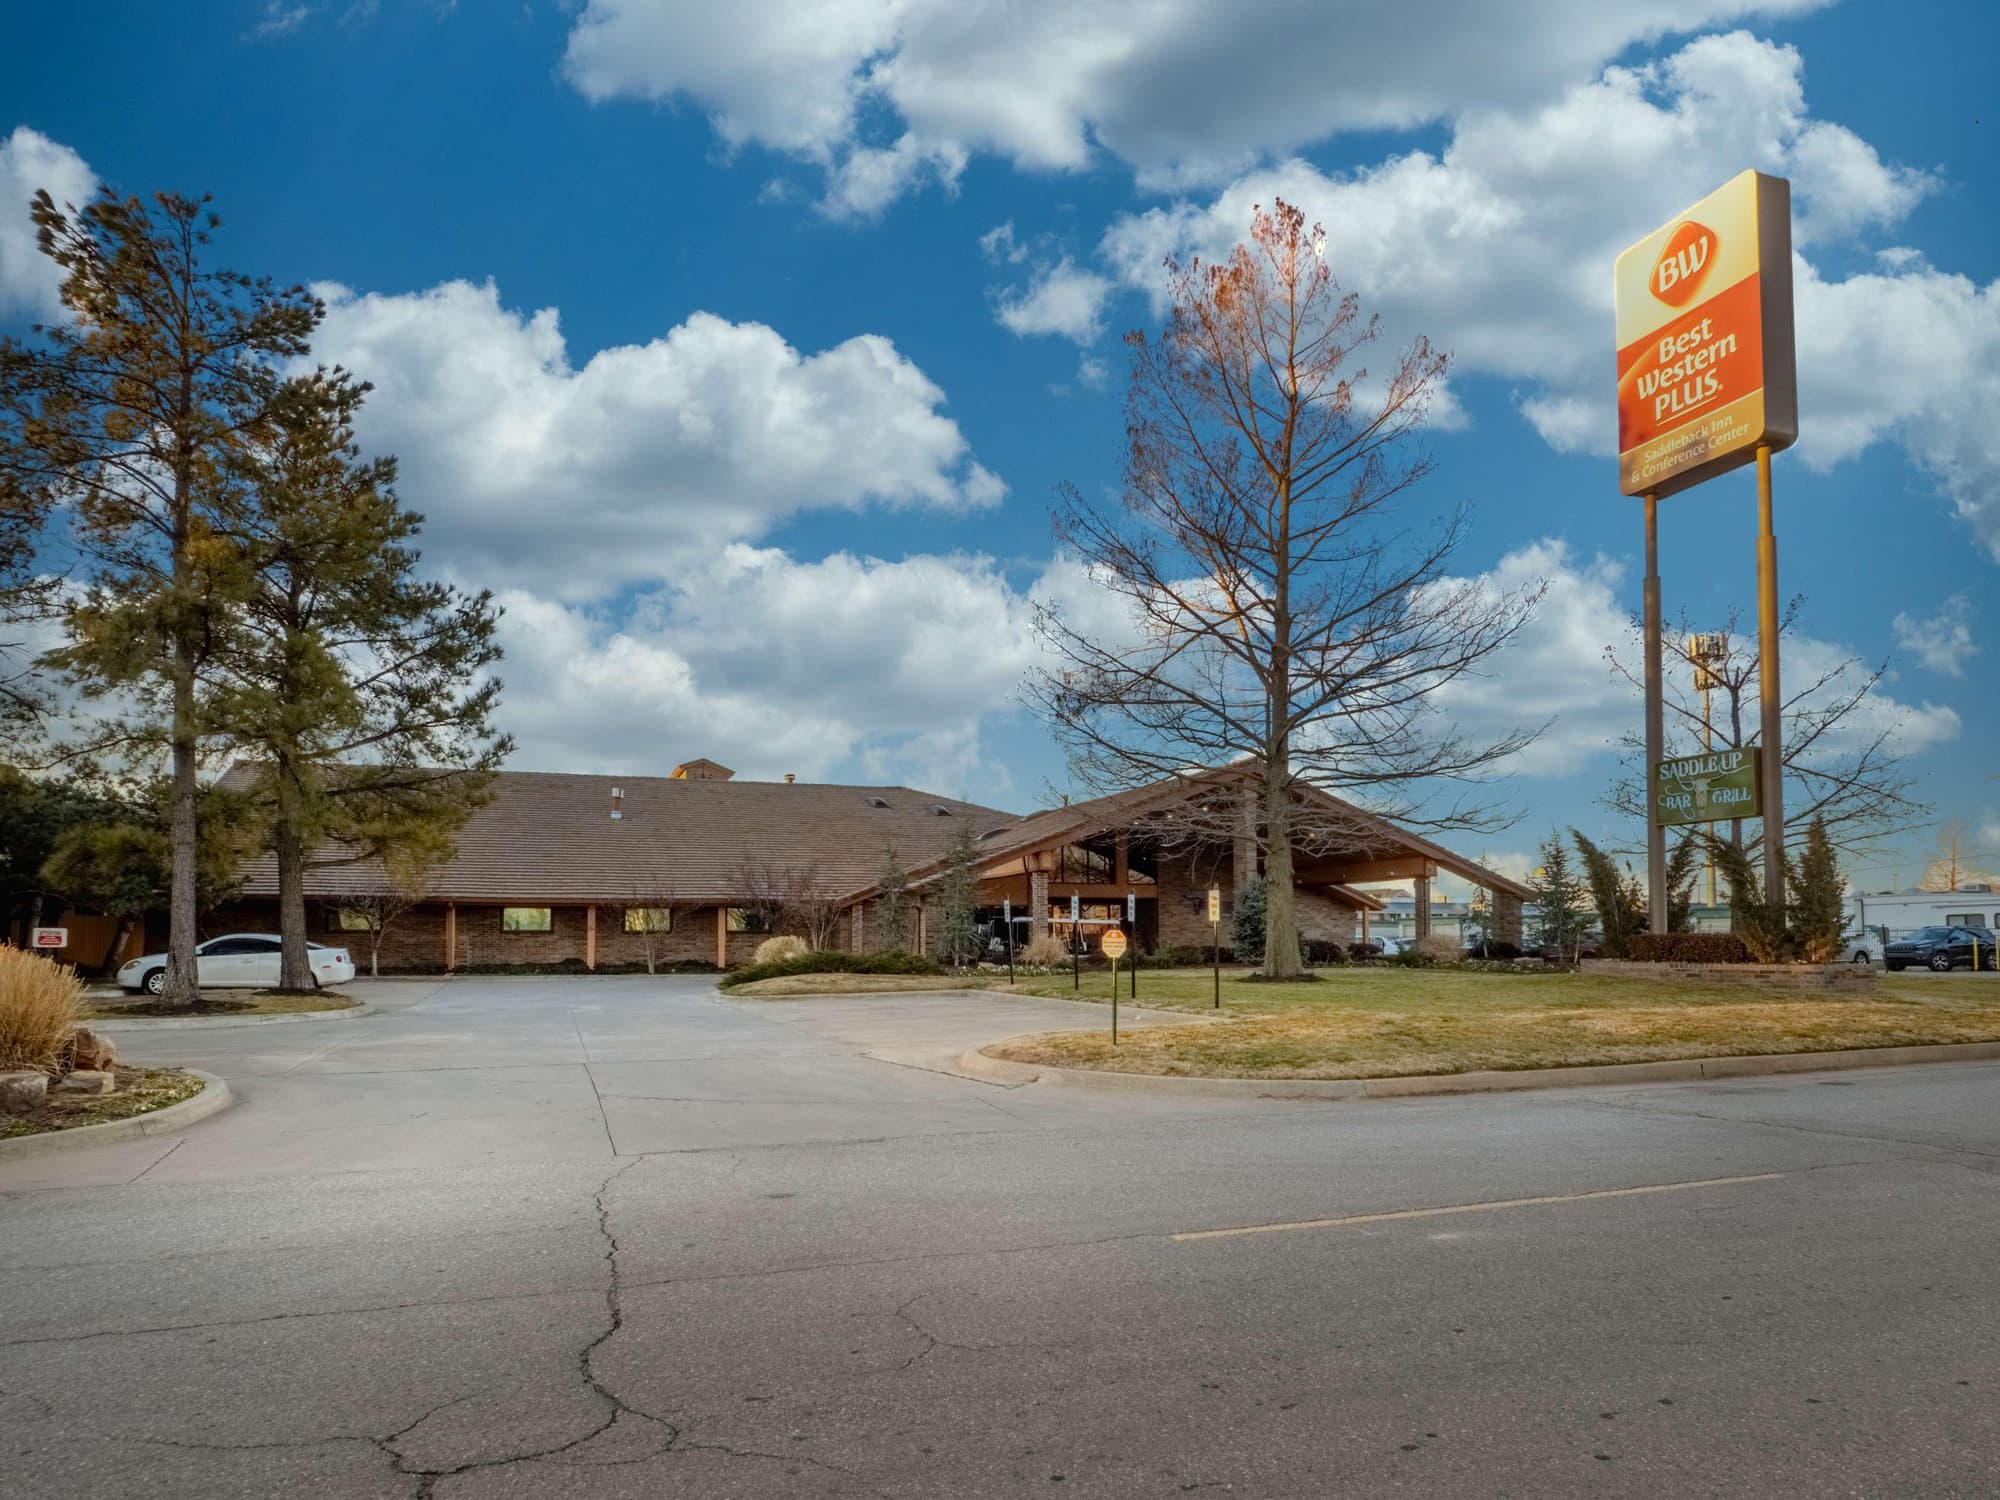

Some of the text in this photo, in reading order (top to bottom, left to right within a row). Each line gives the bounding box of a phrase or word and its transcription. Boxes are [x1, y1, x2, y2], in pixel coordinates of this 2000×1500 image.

[1659, 236, 1709, 291] BW
[1659, 318, 1713, 364] Best
[1637, 334, 1737, 400] Western
[1631, 423, 1749, 483] & Conference Center
[1644, 416, 1733, 462] Saddleback Inn
[1660, 752, 1743, 780] SADDLE UP
[1711, 786, 1752, 805] GRILL
